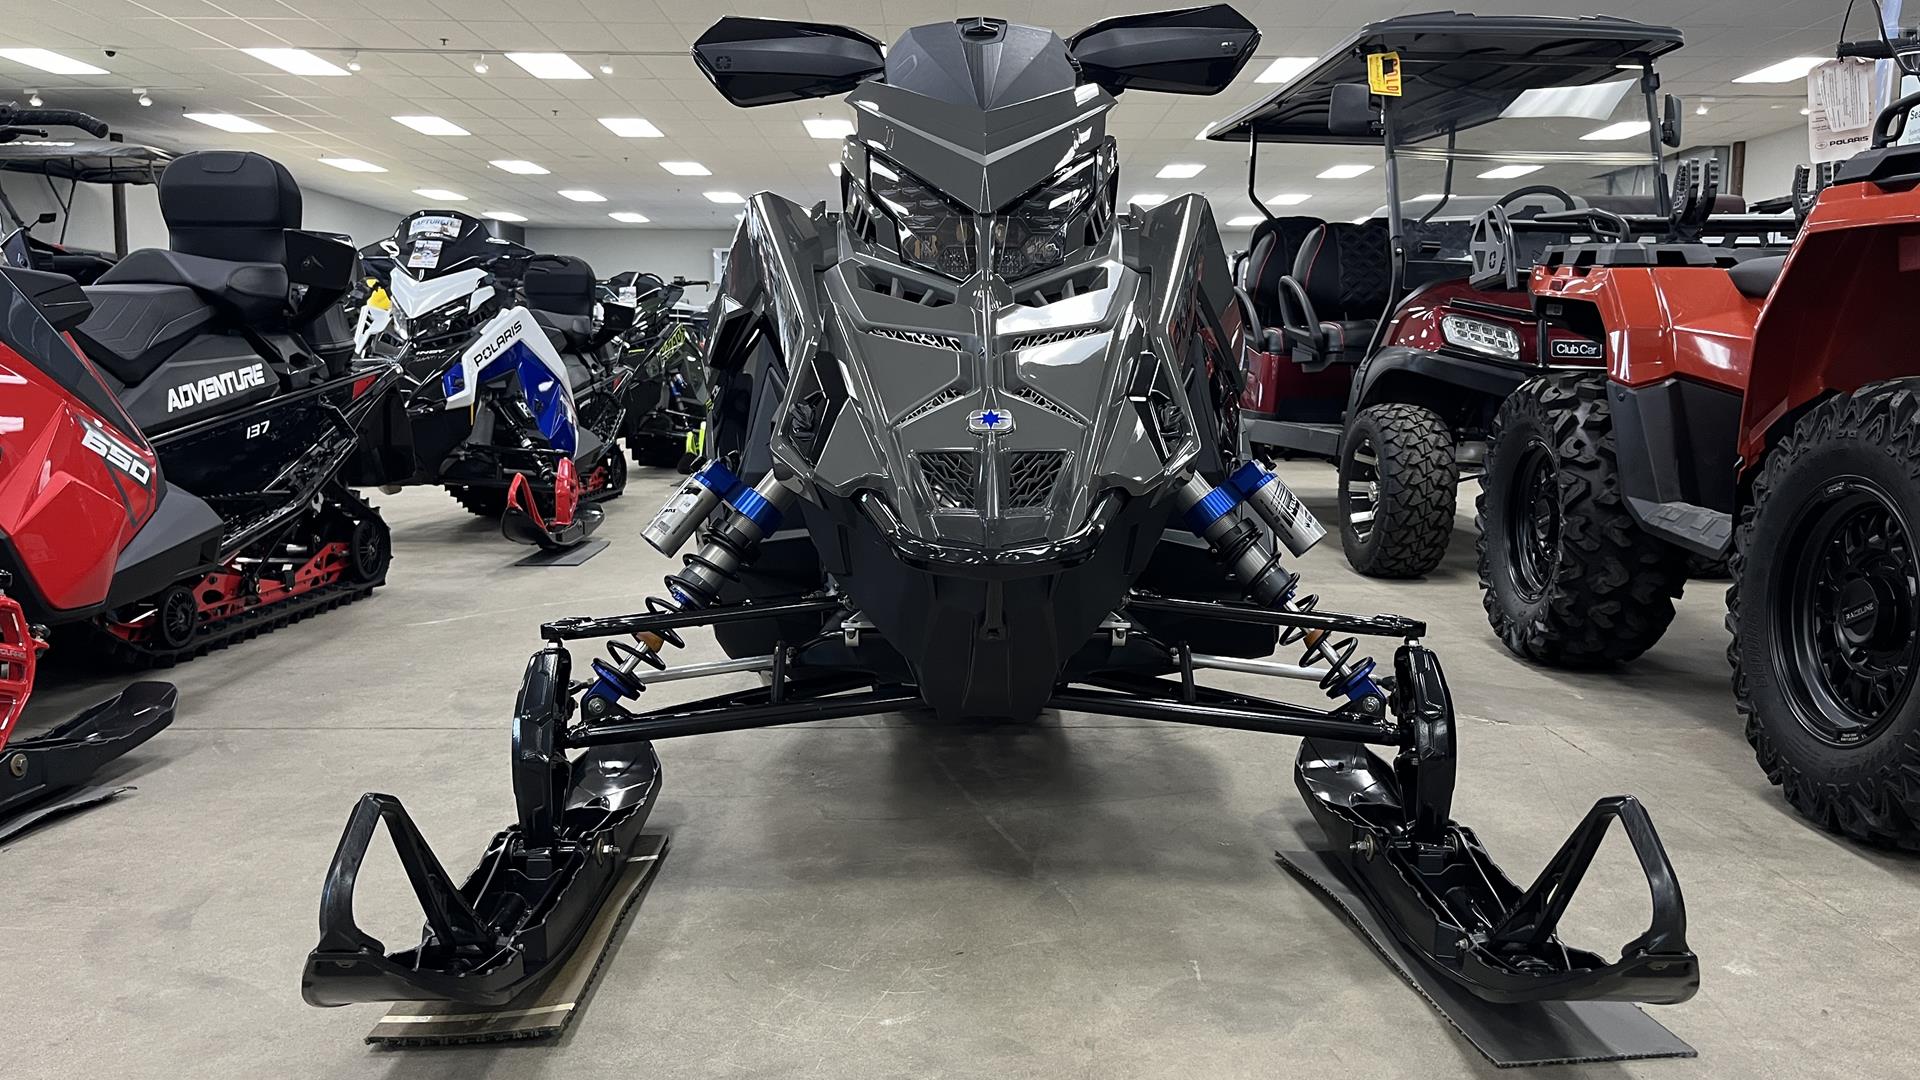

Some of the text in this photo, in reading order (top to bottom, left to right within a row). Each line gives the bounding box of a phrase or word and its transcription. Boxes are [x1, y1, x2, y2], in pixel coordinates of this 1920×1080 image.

[1829, 136, 1869, 147] POLARIS
[473, 320, 523, 368] POLARIS
[1556, 343, 1597, 355] Club Car
[167, 363, 266, 413] ADVENTURE
[246, 420, 271, 440] 137
[81, 429, 150, 485] 650
